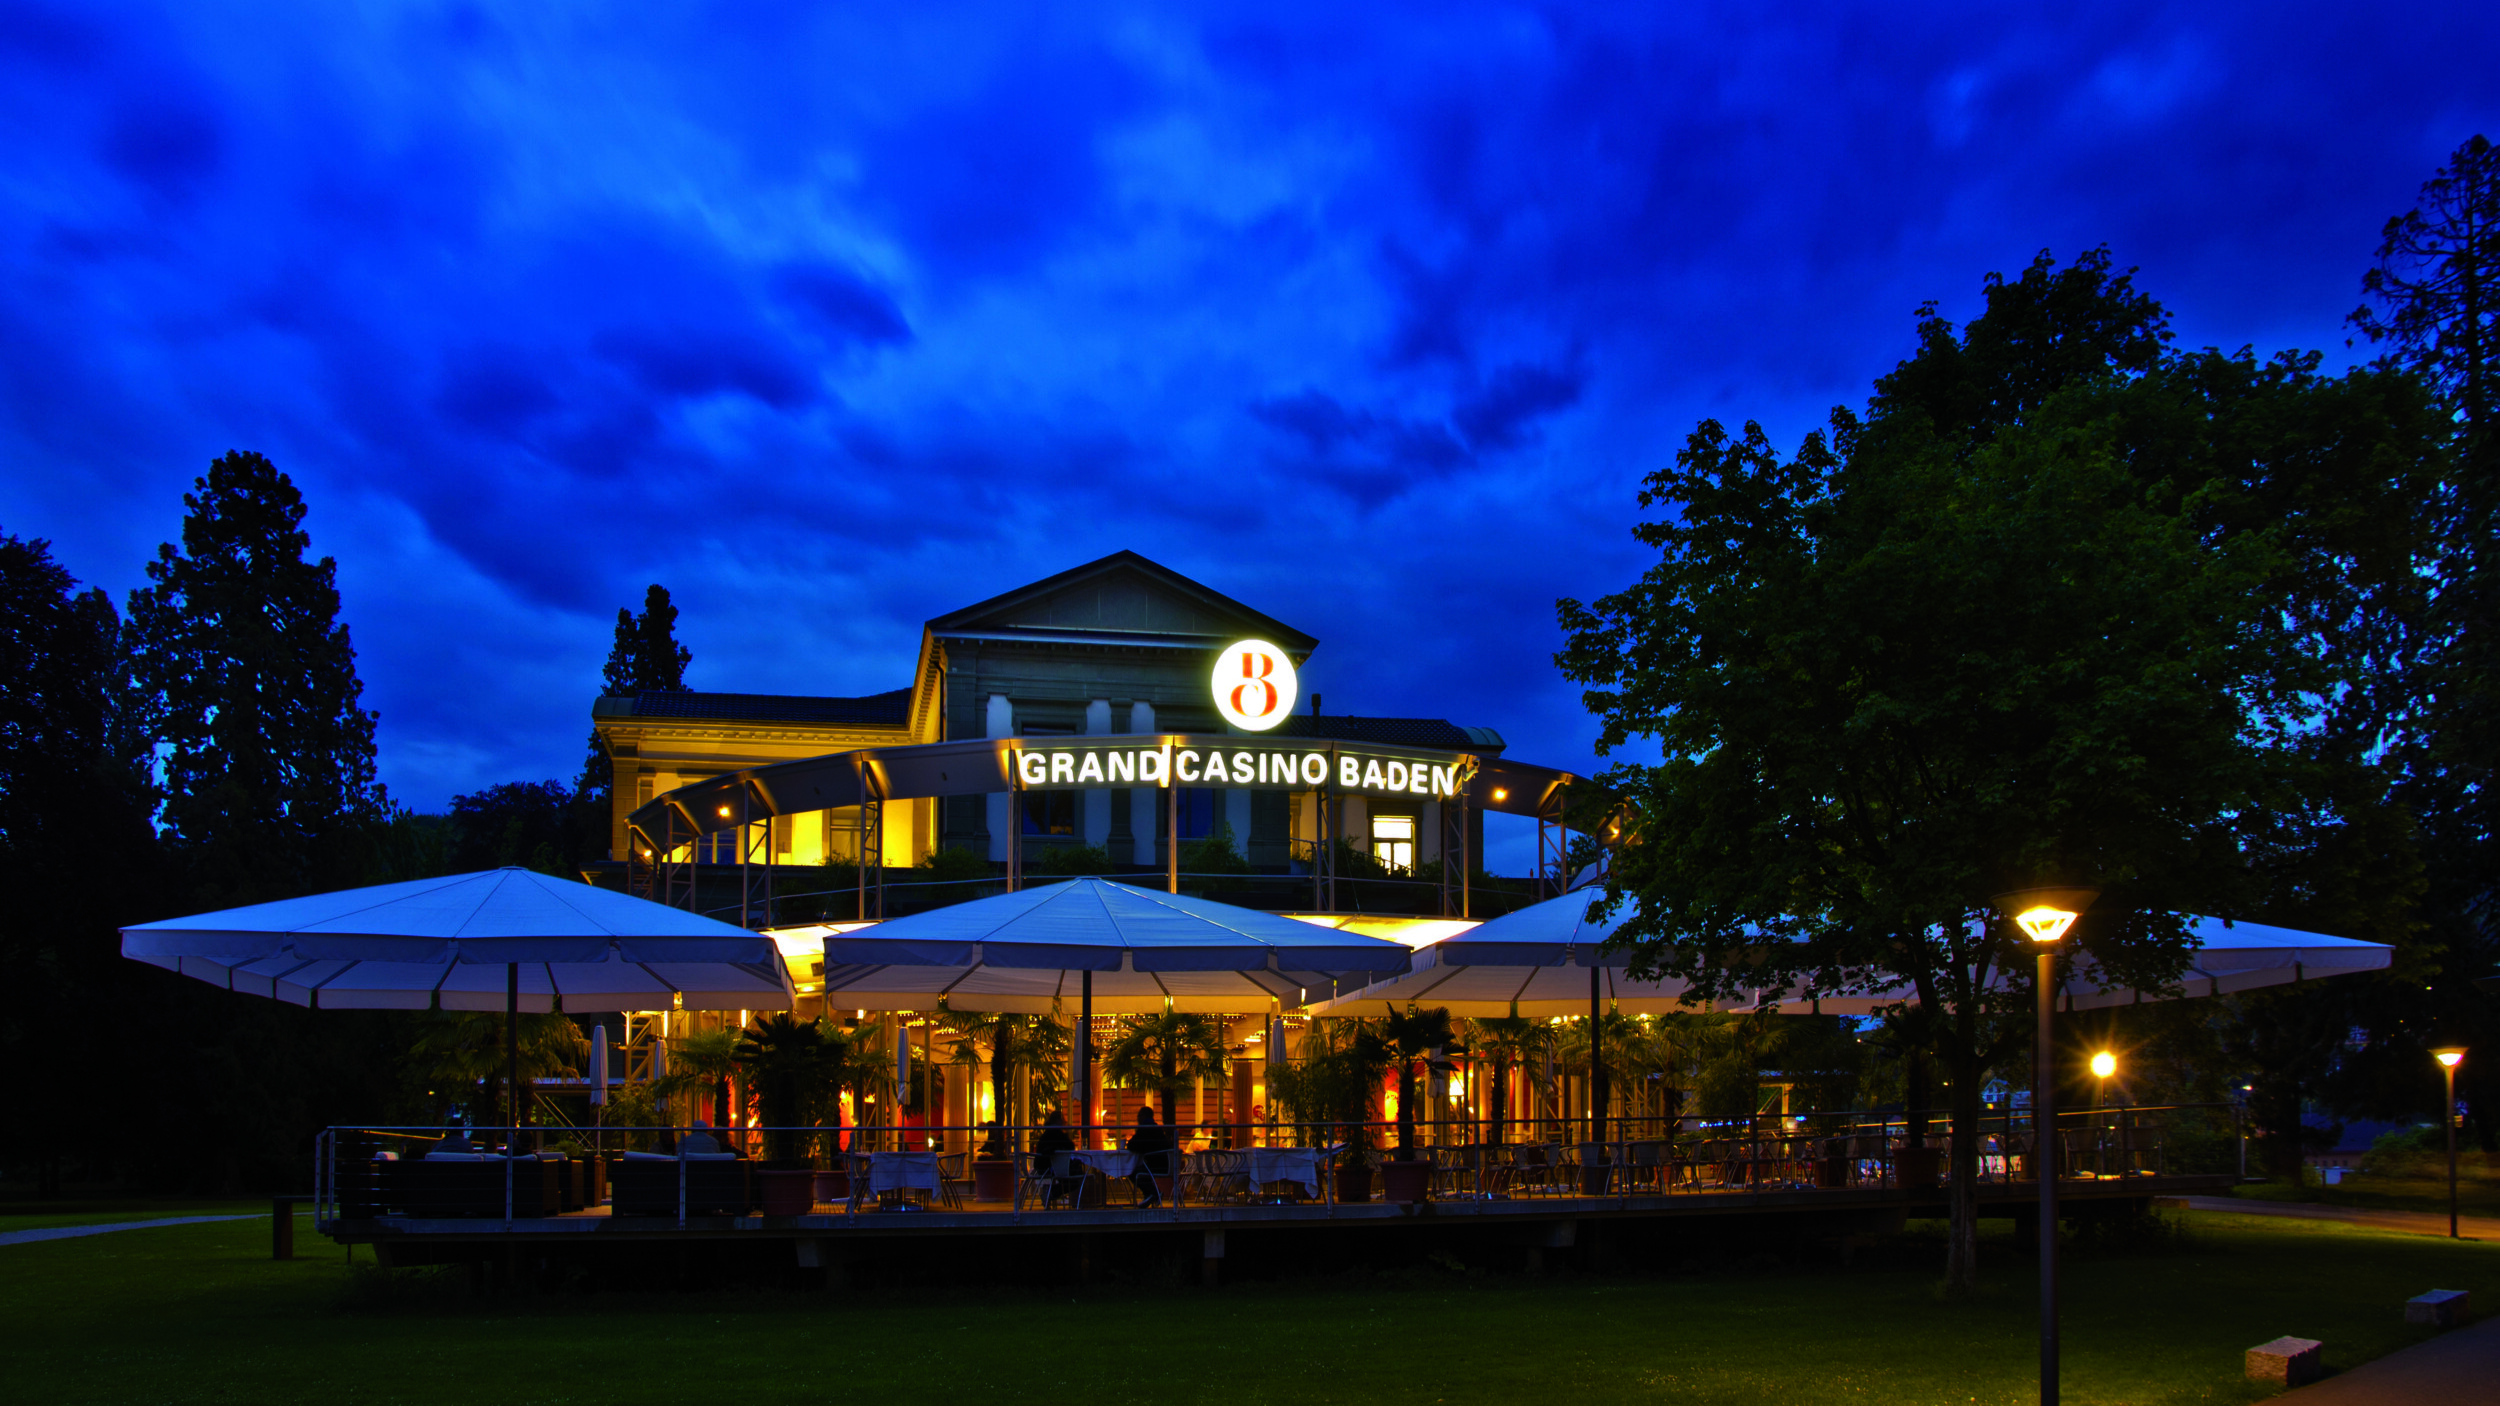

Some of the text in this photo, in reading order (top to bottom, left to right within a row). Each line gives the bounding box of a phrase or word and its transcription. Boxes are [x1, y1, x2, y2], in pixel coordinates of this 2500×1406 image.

[1021, 751, 1455, 796] GRAND CASINO BADEN
